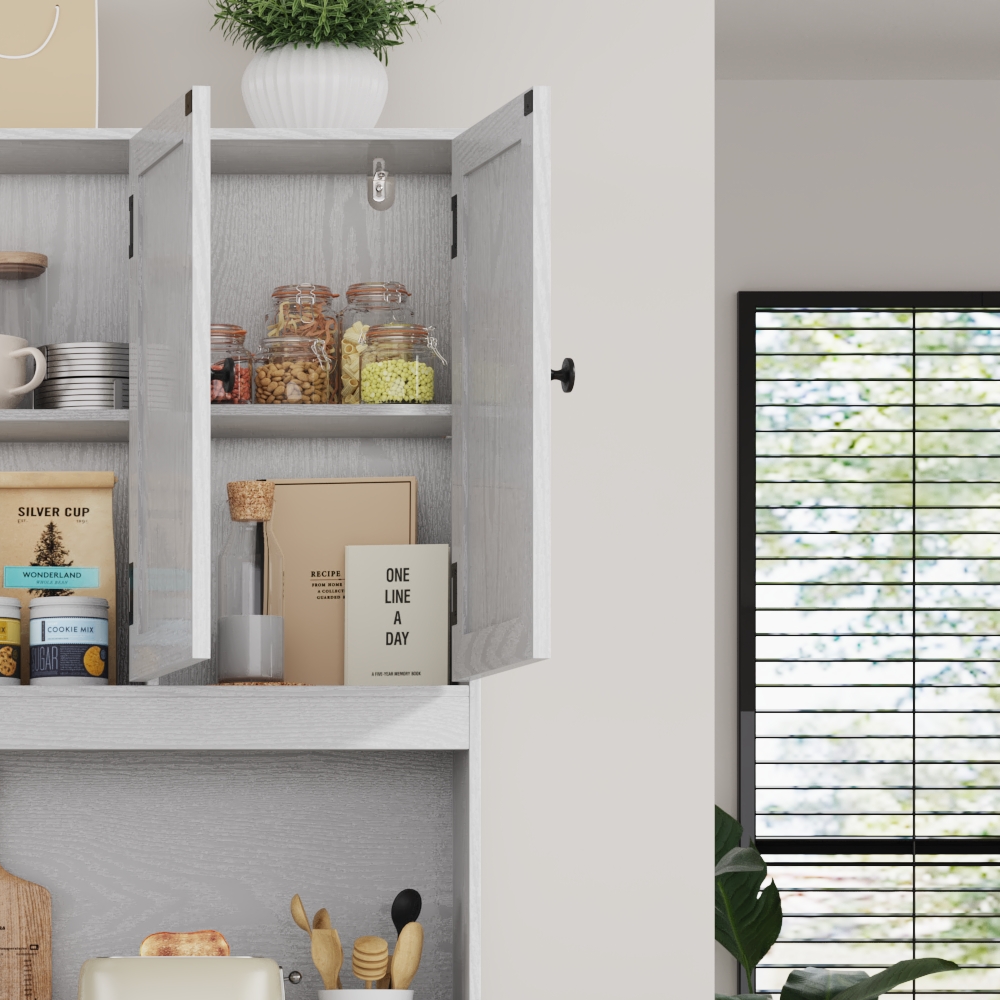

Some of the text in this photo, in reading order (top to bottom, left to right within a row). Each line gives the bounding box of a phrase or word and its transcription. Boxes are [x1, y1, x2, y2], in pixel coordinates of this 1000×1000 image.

[18, 507, 90, 517] SILVER CUP
[386, 568, 410, 582] ONE
[385, 590, 410, 603] LINE
[394, 611, 402, 624] A
[386, 632, 409, 645] DAY
